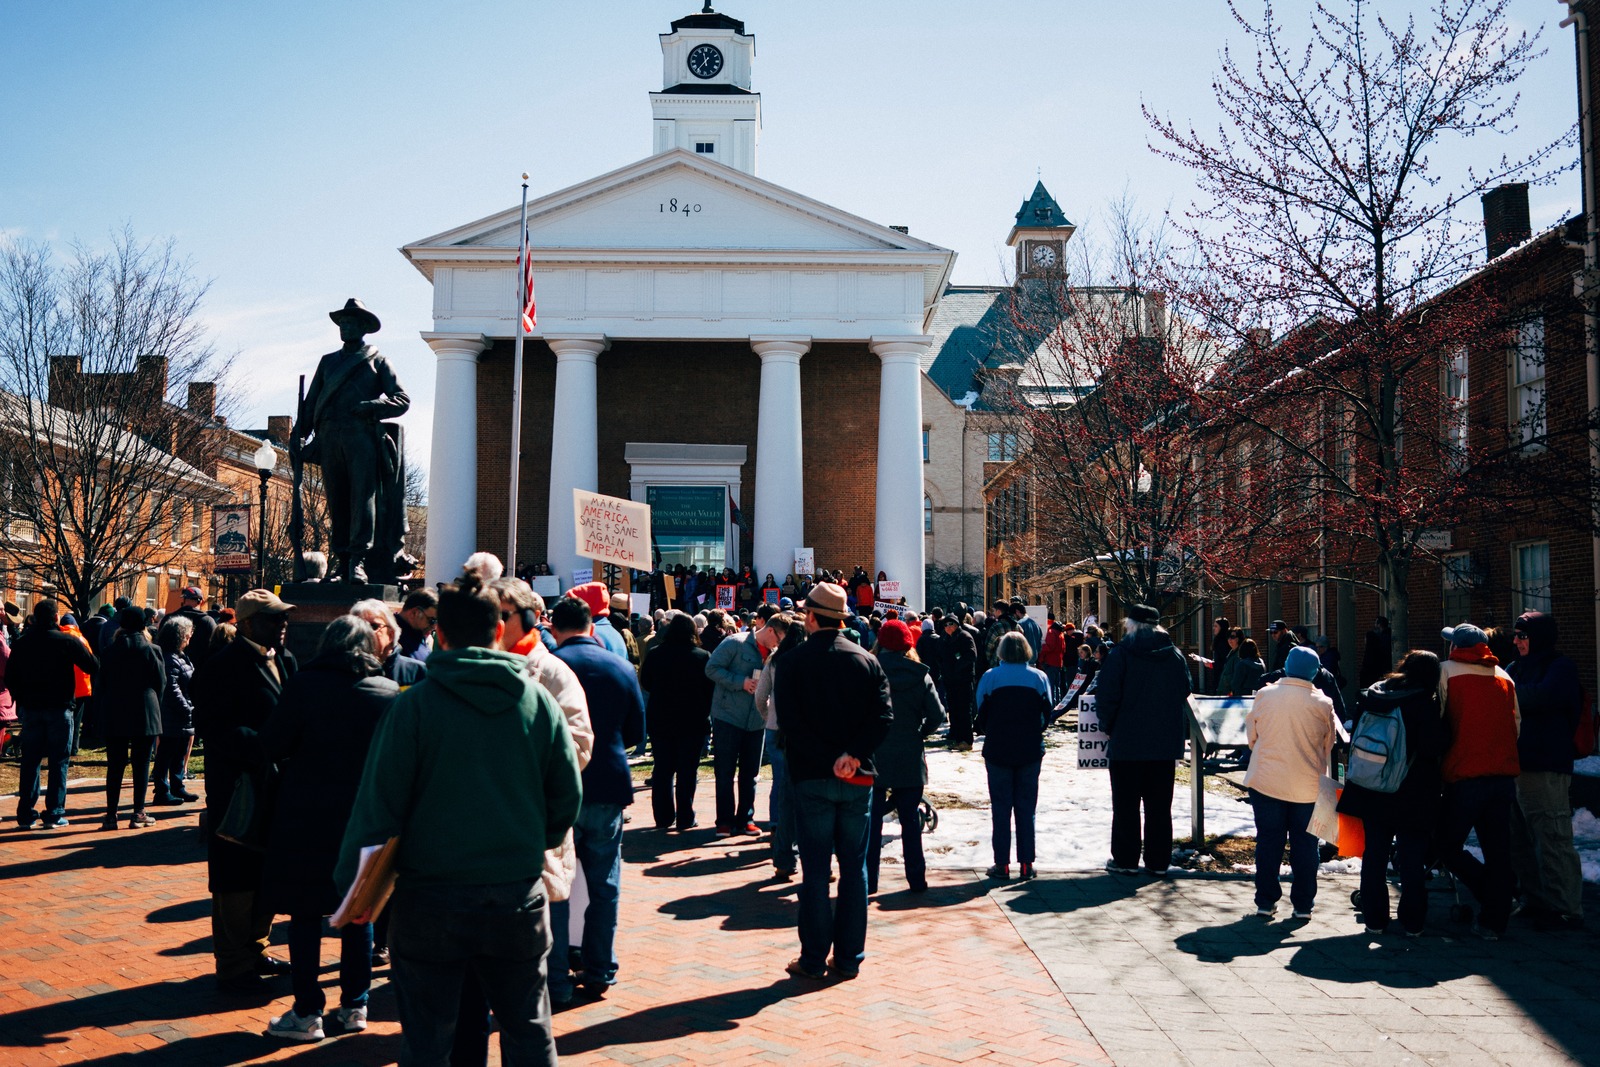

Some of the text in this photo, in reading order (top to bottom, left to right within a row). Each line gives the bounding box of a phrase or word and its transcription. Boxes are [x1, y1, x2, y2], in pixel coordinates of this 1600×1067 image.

[660, 198, 701, 217] 1840
[591, 498, 621, 511] MAKE
[583, 505, 629, 524] AMERICA
[651, 518, 720, 526] CIVIL WAR MUSEUM
[580, 515, 602, 531] SAFE
[614, 523, 638, 538] SANE
[589, 531, 625, 547] AGAIN
[584, 539, 635, 562] IMPEACH
[1079, 739, 1108, 752] tary
[1079, 758, 1108, 767] wea
